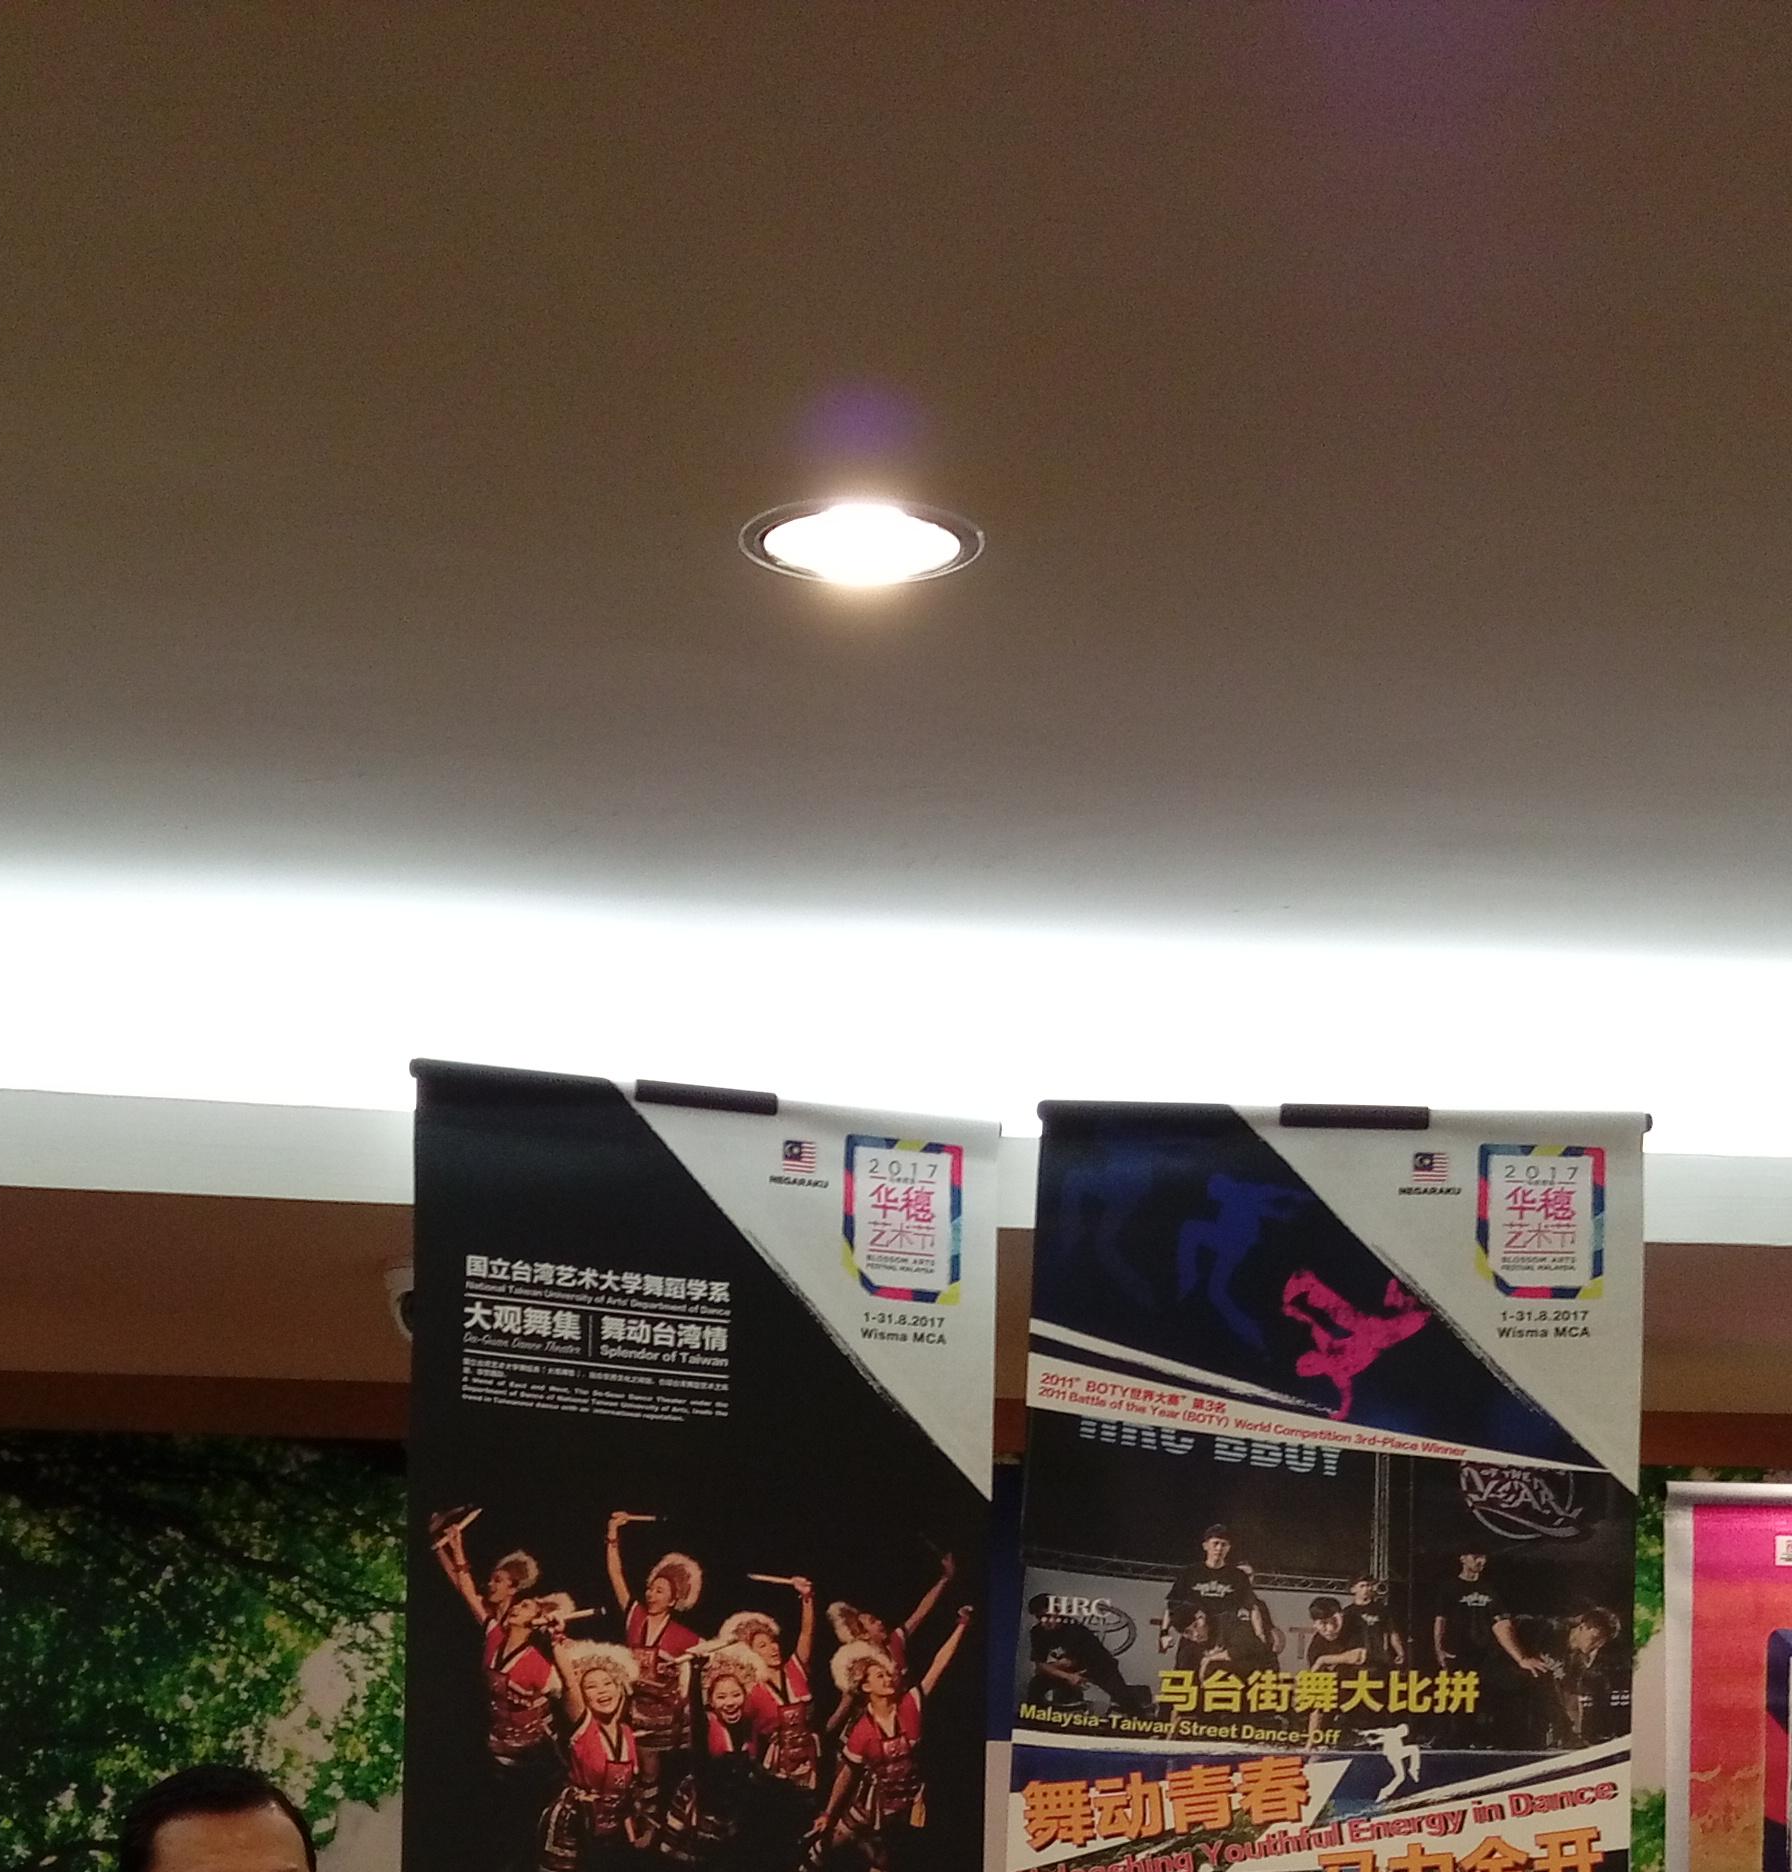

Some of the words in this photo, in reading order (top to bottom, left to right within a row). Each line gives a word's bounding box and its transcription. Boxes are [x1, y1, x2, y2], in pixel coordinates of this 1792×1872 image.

[869, 1158, 938, 1178] 2017
[1504, 1165, 1579, 1180] 2017
[463, 1301, 583, 1341] 大观舞集
[599, 1314, 730, 1353] 舞动台湾情
[863, 1311, 946, 1329] 1-31.8.2017
[1500, 1310, 1589, 1322] 1-31.8.2017
[860, 1328, 908, 1343] Wisma
[913, 1333, 947, 1346] MCA
[1497, 1326, 1549, 1338] Wisma
[1553, 1326, 1591, 1338] MCA
[599, 1343, 659, 1363] Splendor
[661, 1351, 677, 1364] of
[679, 1351, 730, 1368] Taiwan
[1038, 1385, 1068, 1402] 2011
[1069, 1389, 1108, 1408] Battle
[1109, 1396, 1127, 1411] of
[1127, 1398, 1148, 1414] the
[1149, 1402, 1181, 1421] Year
[1234, 1416, 1272, 1436] World
[1273, 1422, 1352, 1445] Competition
[1354, 1432, 1419, 1453] 3rd-Place
[1420, 1442, 1468, 1458] Winner
[1155, 1668, 1480, 1715] 马台街舞大比拼
[1018, 1701, 1176, 1735] Malaysia-Taiwan
[1179, 1718, 1239, 1740] Street
[1240, 1724, 1342, 1746] Dance-Off
[1021, 1755, 1311, 1849] 舞动青春
[1204, 1820, 1345, 1869] Youthful
[1349, 1805, 1465, 1846] Energy
[1471, 1798, 1504, 1826] in
[1507, 1778, 1619, 1819] Dance
